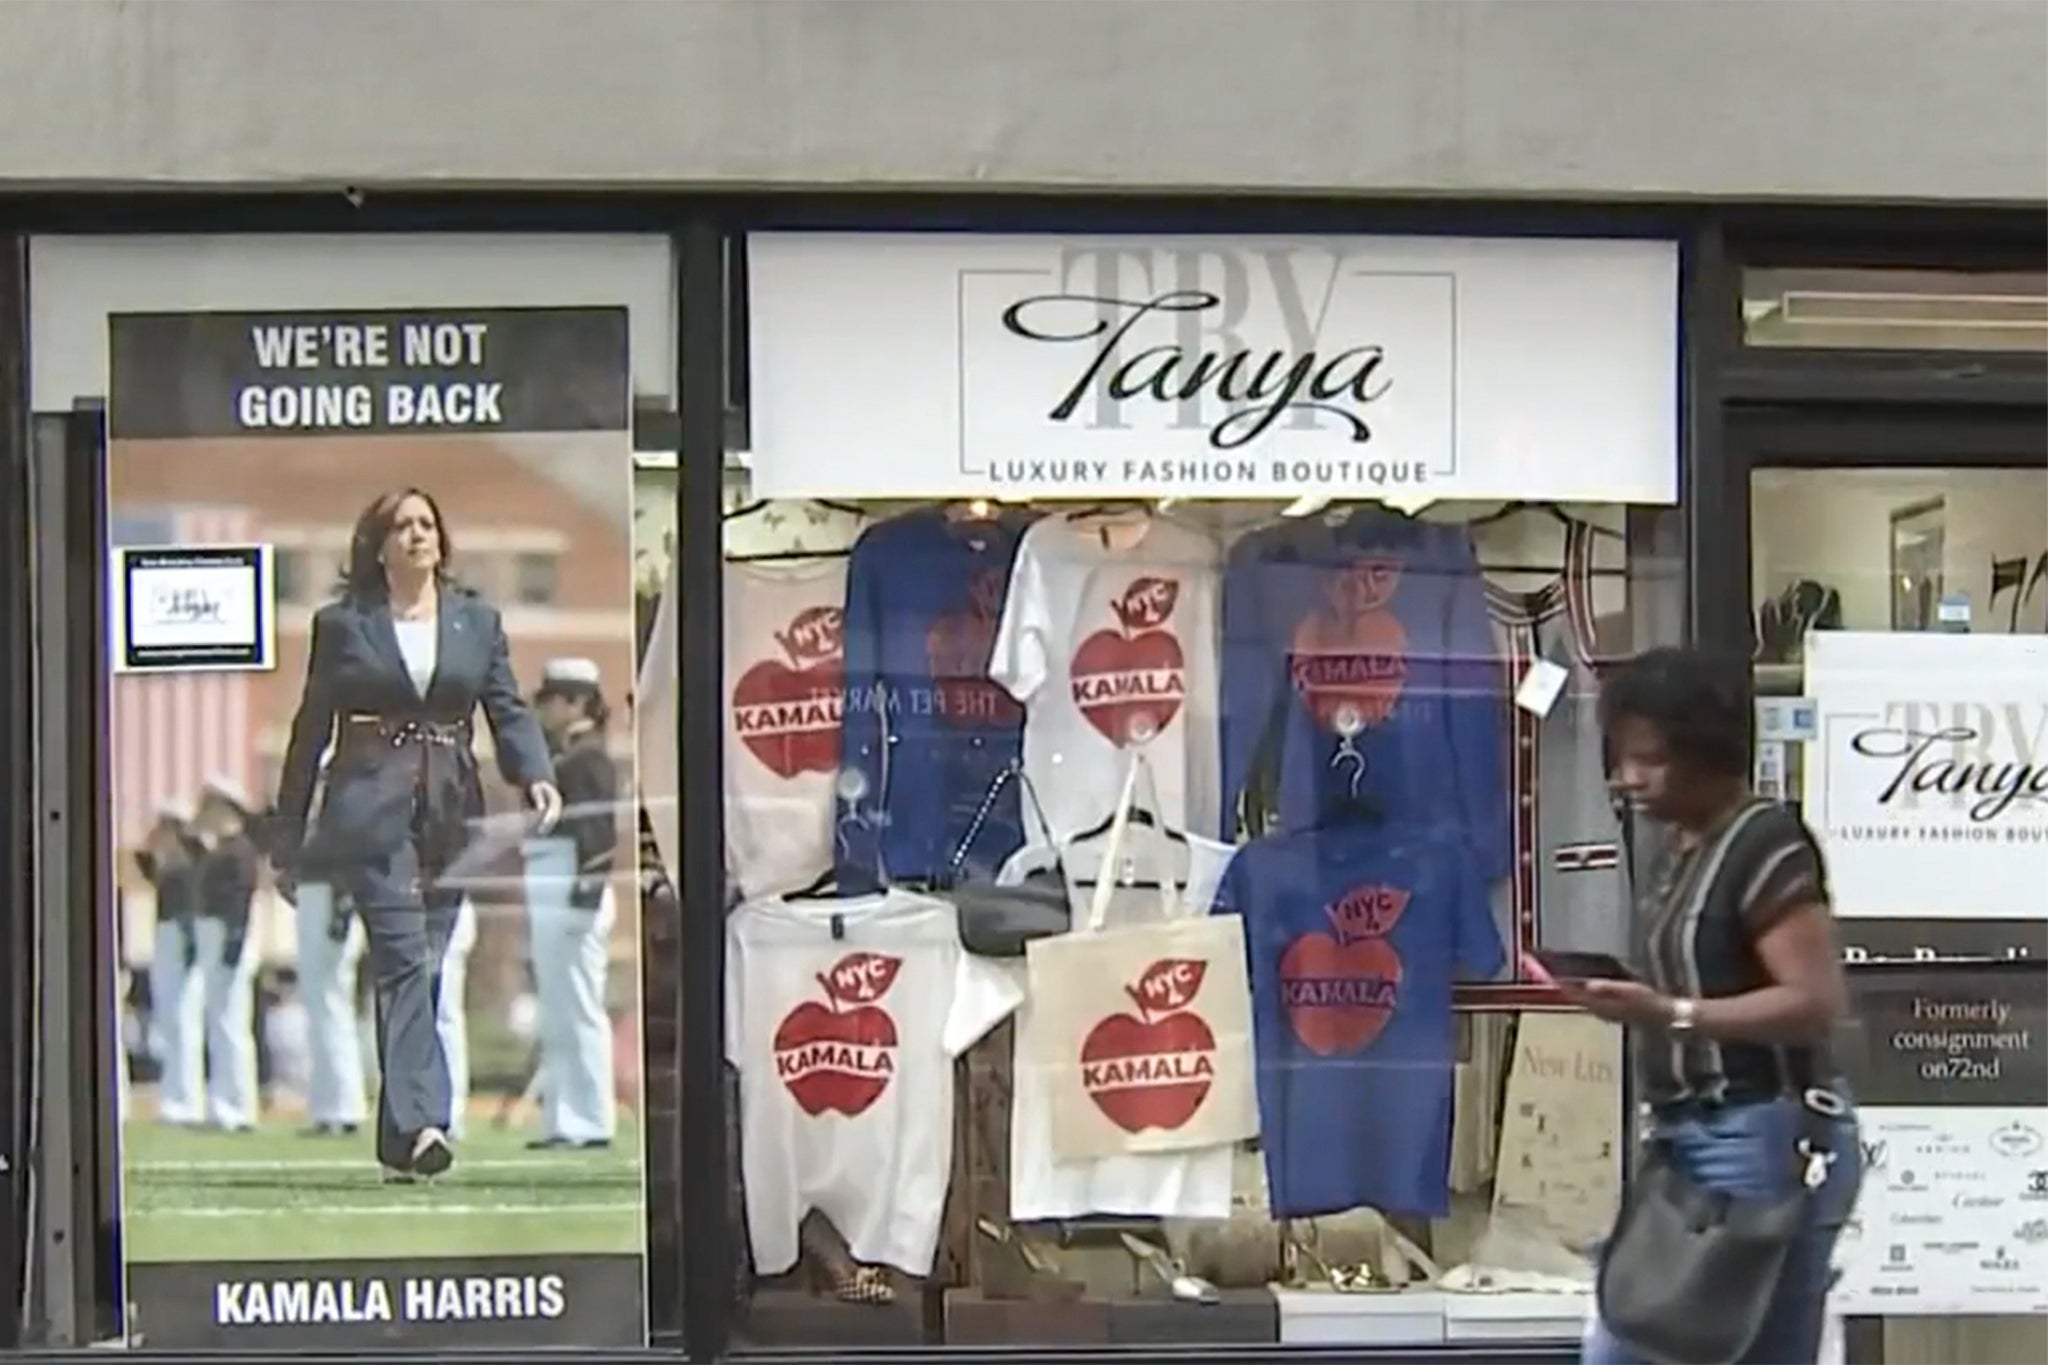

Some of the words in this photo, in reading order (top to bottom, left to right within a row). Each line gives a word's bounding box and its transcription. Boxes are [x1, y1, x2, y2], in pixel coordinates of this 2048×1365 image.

[253, 324, 389, 368] WE'RE
[404, 323, 488, 367] NOT
[1003, 290, 1393, 450] Tanya
[239, 384, 372, 427] GOING
[387, 383, 502, 425] BACK
[989, 459, 1107, 483] LUXURY
[1123, 461, 1255, 482] FASHION
[1273, 461, 1427, 484] BOUTIQUE
[794, 611, 841, 648] NYC
[1072, 671, 1186, 703] KAMALA
[735, 699, 844, 732] KAMAL
[1841, 825, 1910, 841] LUXURY
[1919, 825, 1998, 842] FASHION
[2006, 825, 2048, 842] BOU
[1344, 892, 1392, 921] NYC
[835, 958, 886, 990] NYC
[1144, 963, 1193, 999] NYC
[1281, 980, 1398, 1009] KAMALA
[1914, 997, 2011, 1025] Formerly
[1893, 1027, 2029, 1055] consignment
[776, 1044, 894, 1078] KAMALA
[1082, 1055, 1215, 1088] KAMALA
[1921, 1057, 2000, 1079] on72nd
[216, 1280, 391, 1323] KAMALA
[406, 1275, 565, 1320] HARRIS
